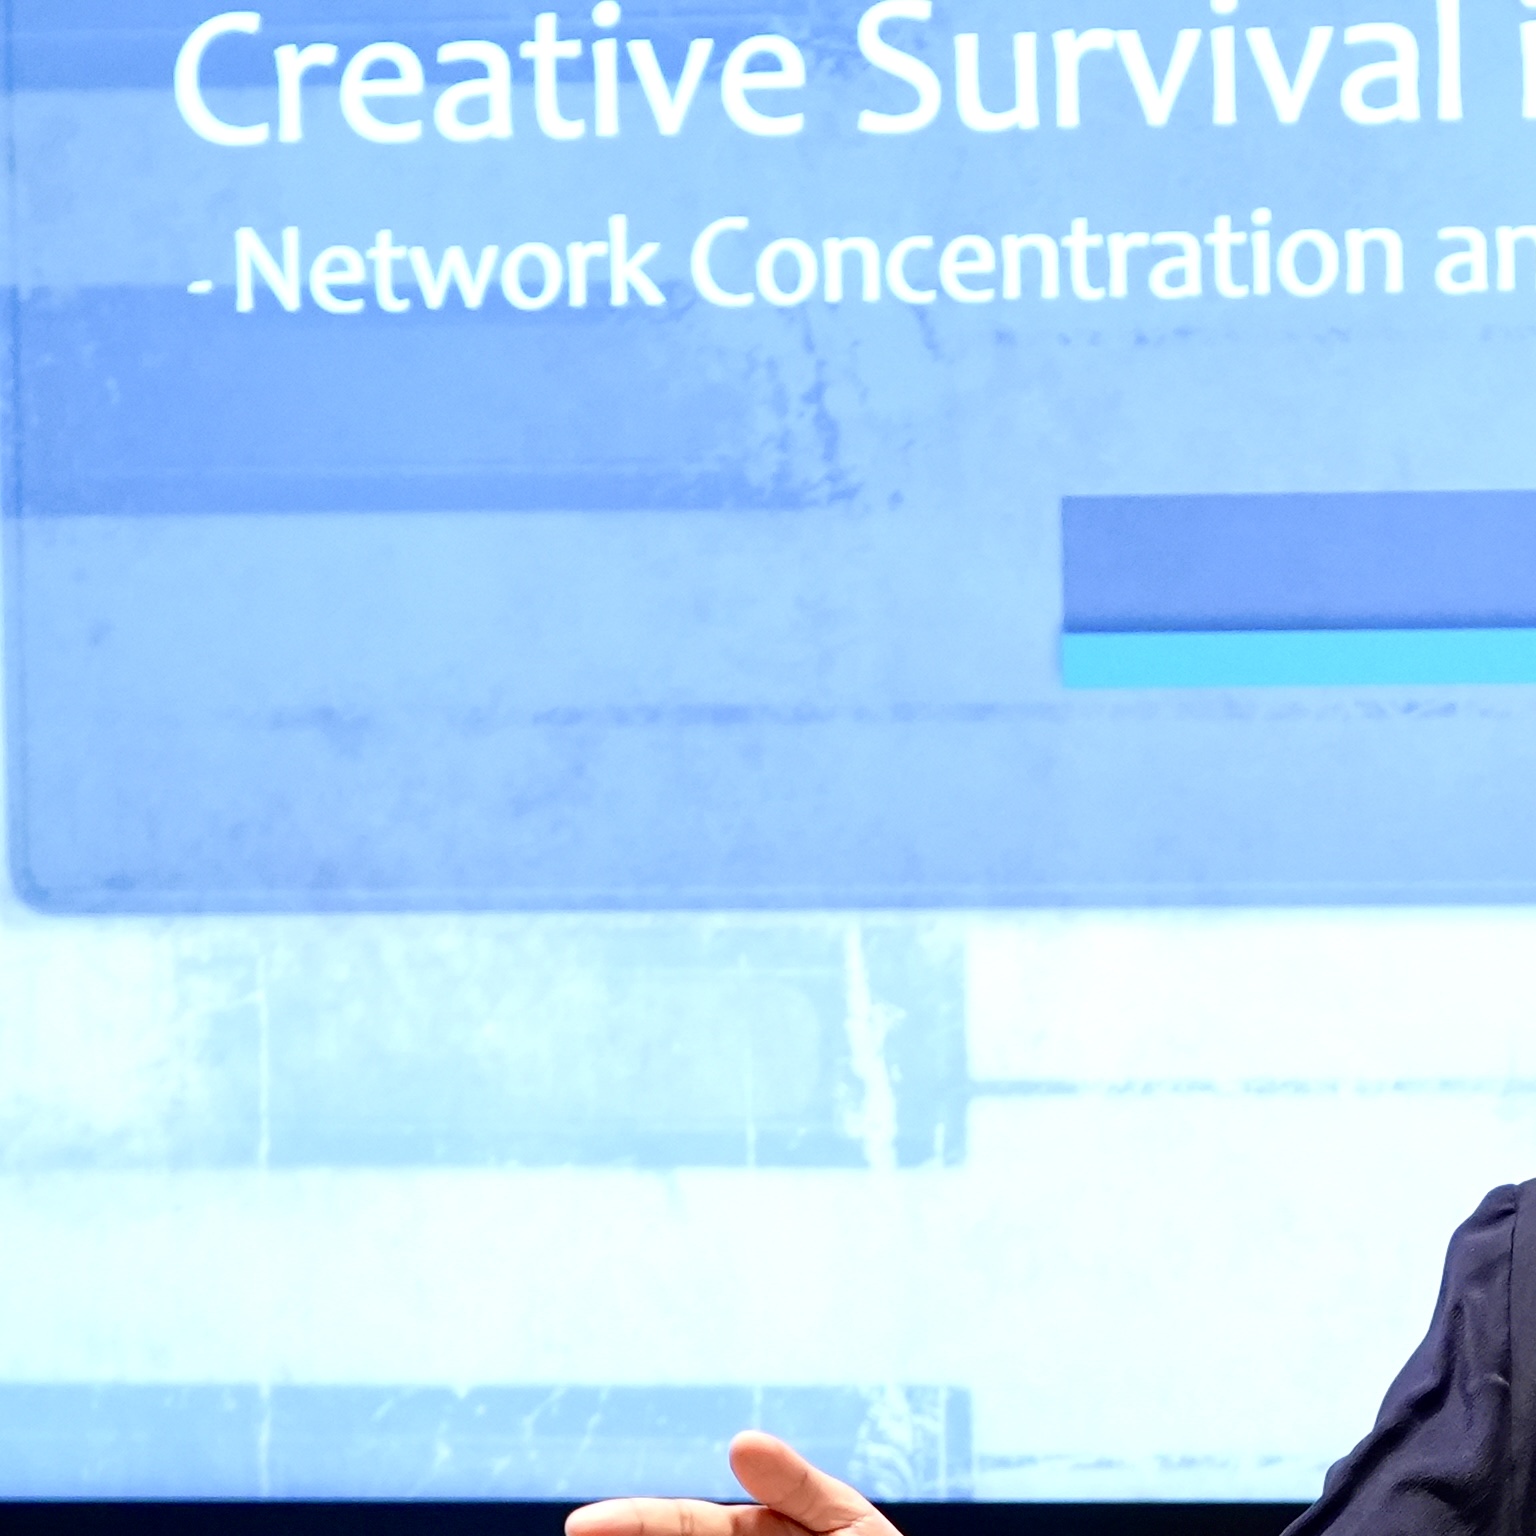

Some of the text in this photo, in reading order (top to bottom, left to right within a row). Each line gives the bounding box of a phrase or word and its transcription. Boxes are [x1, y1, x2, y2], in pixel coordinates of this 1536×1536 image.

[174, 1, 806, 147] Creative
[856, 0, 1464, 135] Survival
[235, 214, 666, 314] Network
[690, 208, 1404, 309] Concentration
